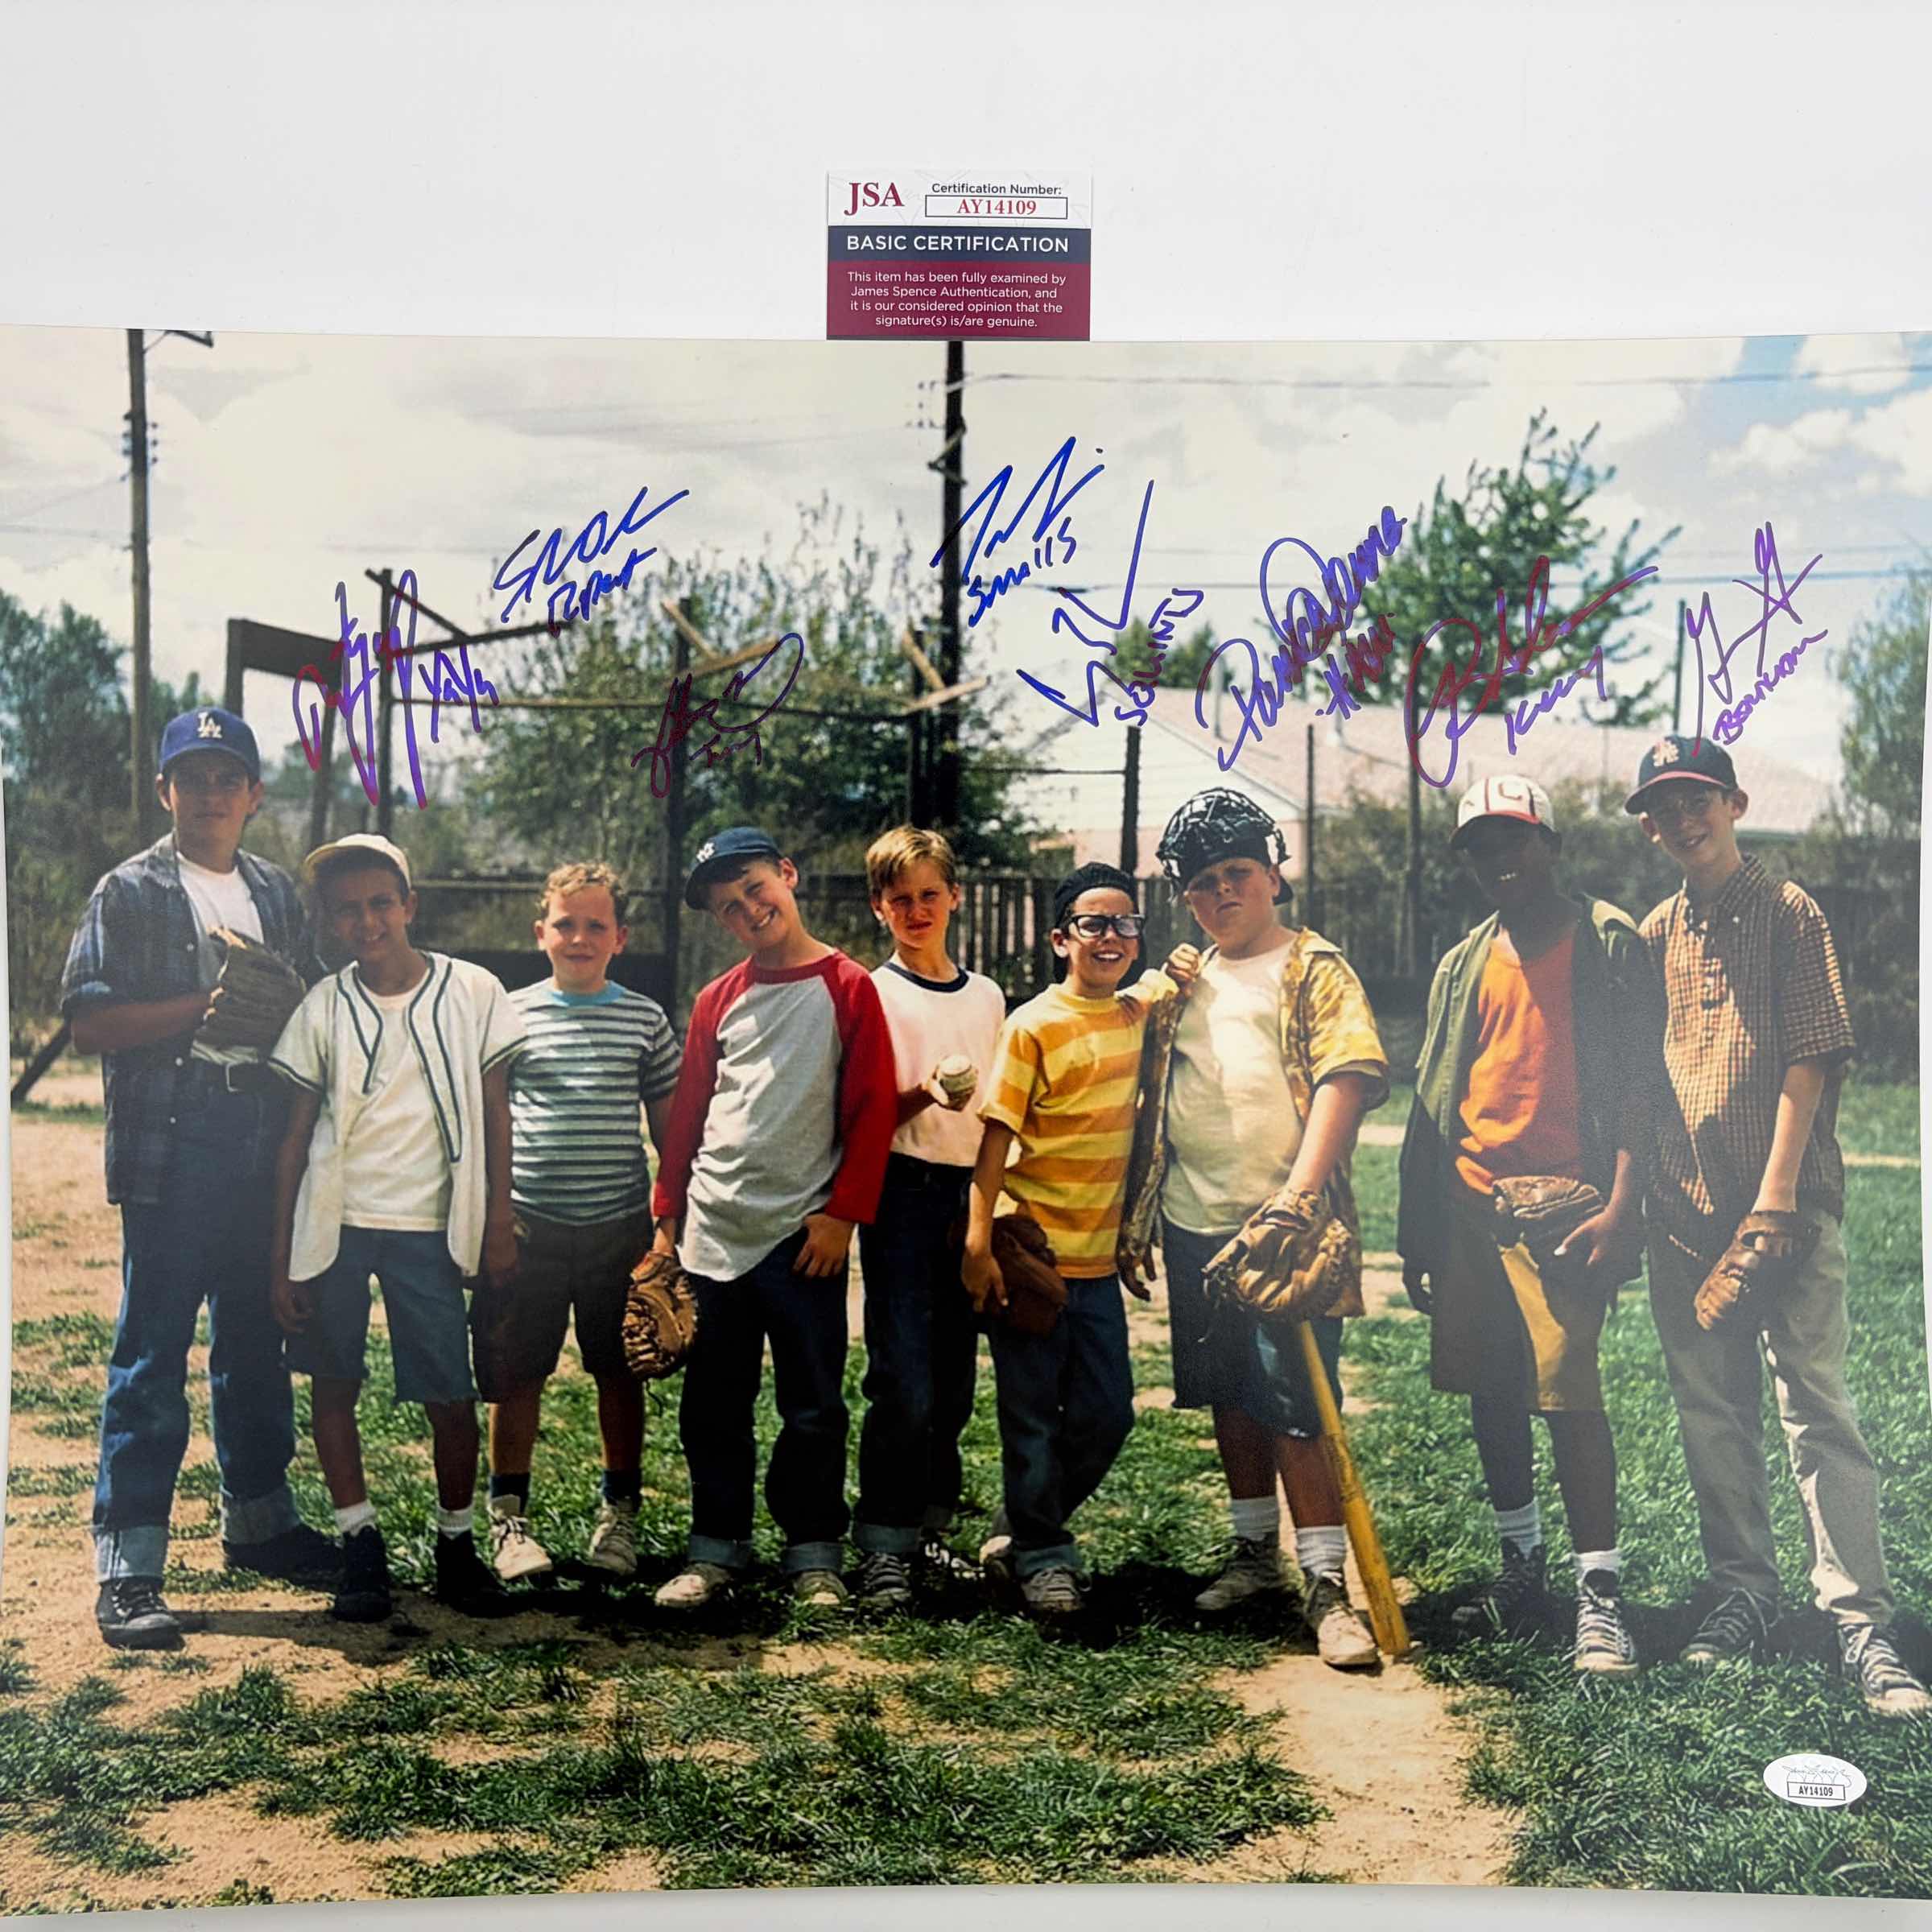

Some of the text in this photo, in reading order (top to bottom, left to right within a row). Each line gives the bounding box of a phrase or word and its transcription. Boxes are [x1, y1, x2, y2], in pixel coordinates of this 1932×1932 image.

[931, 183, 1062, 195] Certification Number:
[844, 182, 905, 217] JSA
[957, 199, 1037, 215] AY14109
[847, 235, 1069, 253] BASIC CERTIFICATION
[848, 271, 1067, 286] This item has been fully examined by
[851, 287, 1057, 299] James Spence Authentication, and
[850, 300, 1063, 313] it is our considered opinion that the
[875, 315, 1038, 328] signature(s) is/are genuine.
[197, 712, 222, 738] LA
[1798, 1785, 1834, 1797] AY14109
